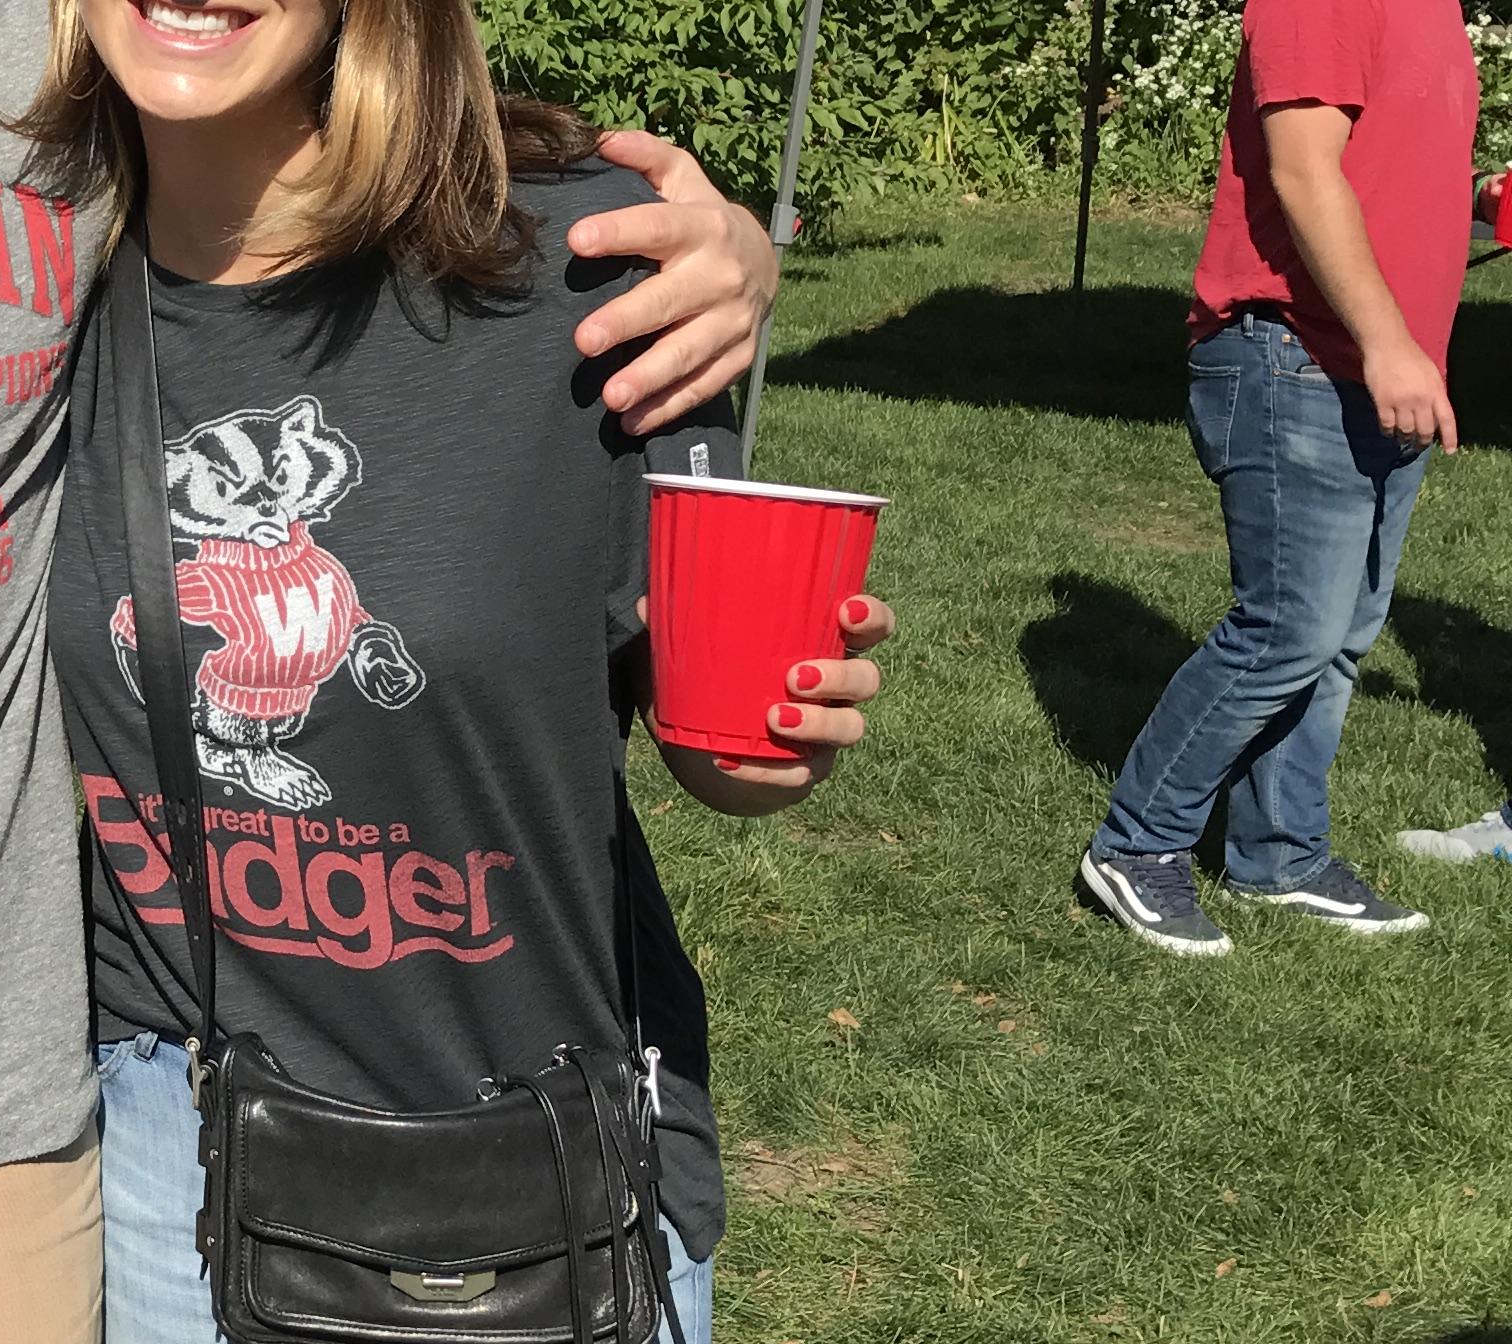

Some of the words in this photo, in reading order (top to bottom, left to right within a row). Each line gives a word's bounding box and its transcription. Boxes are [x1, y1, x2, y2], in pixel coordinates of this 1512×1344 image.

[256, 573, 335, 658] W
[137, 792, 164, 823] it'
[297, 813, 331, 845] to
[335, 816, 381, 847] be
[389, 821, 412, 844] a
[81, 773, 516, 969] Bdger
